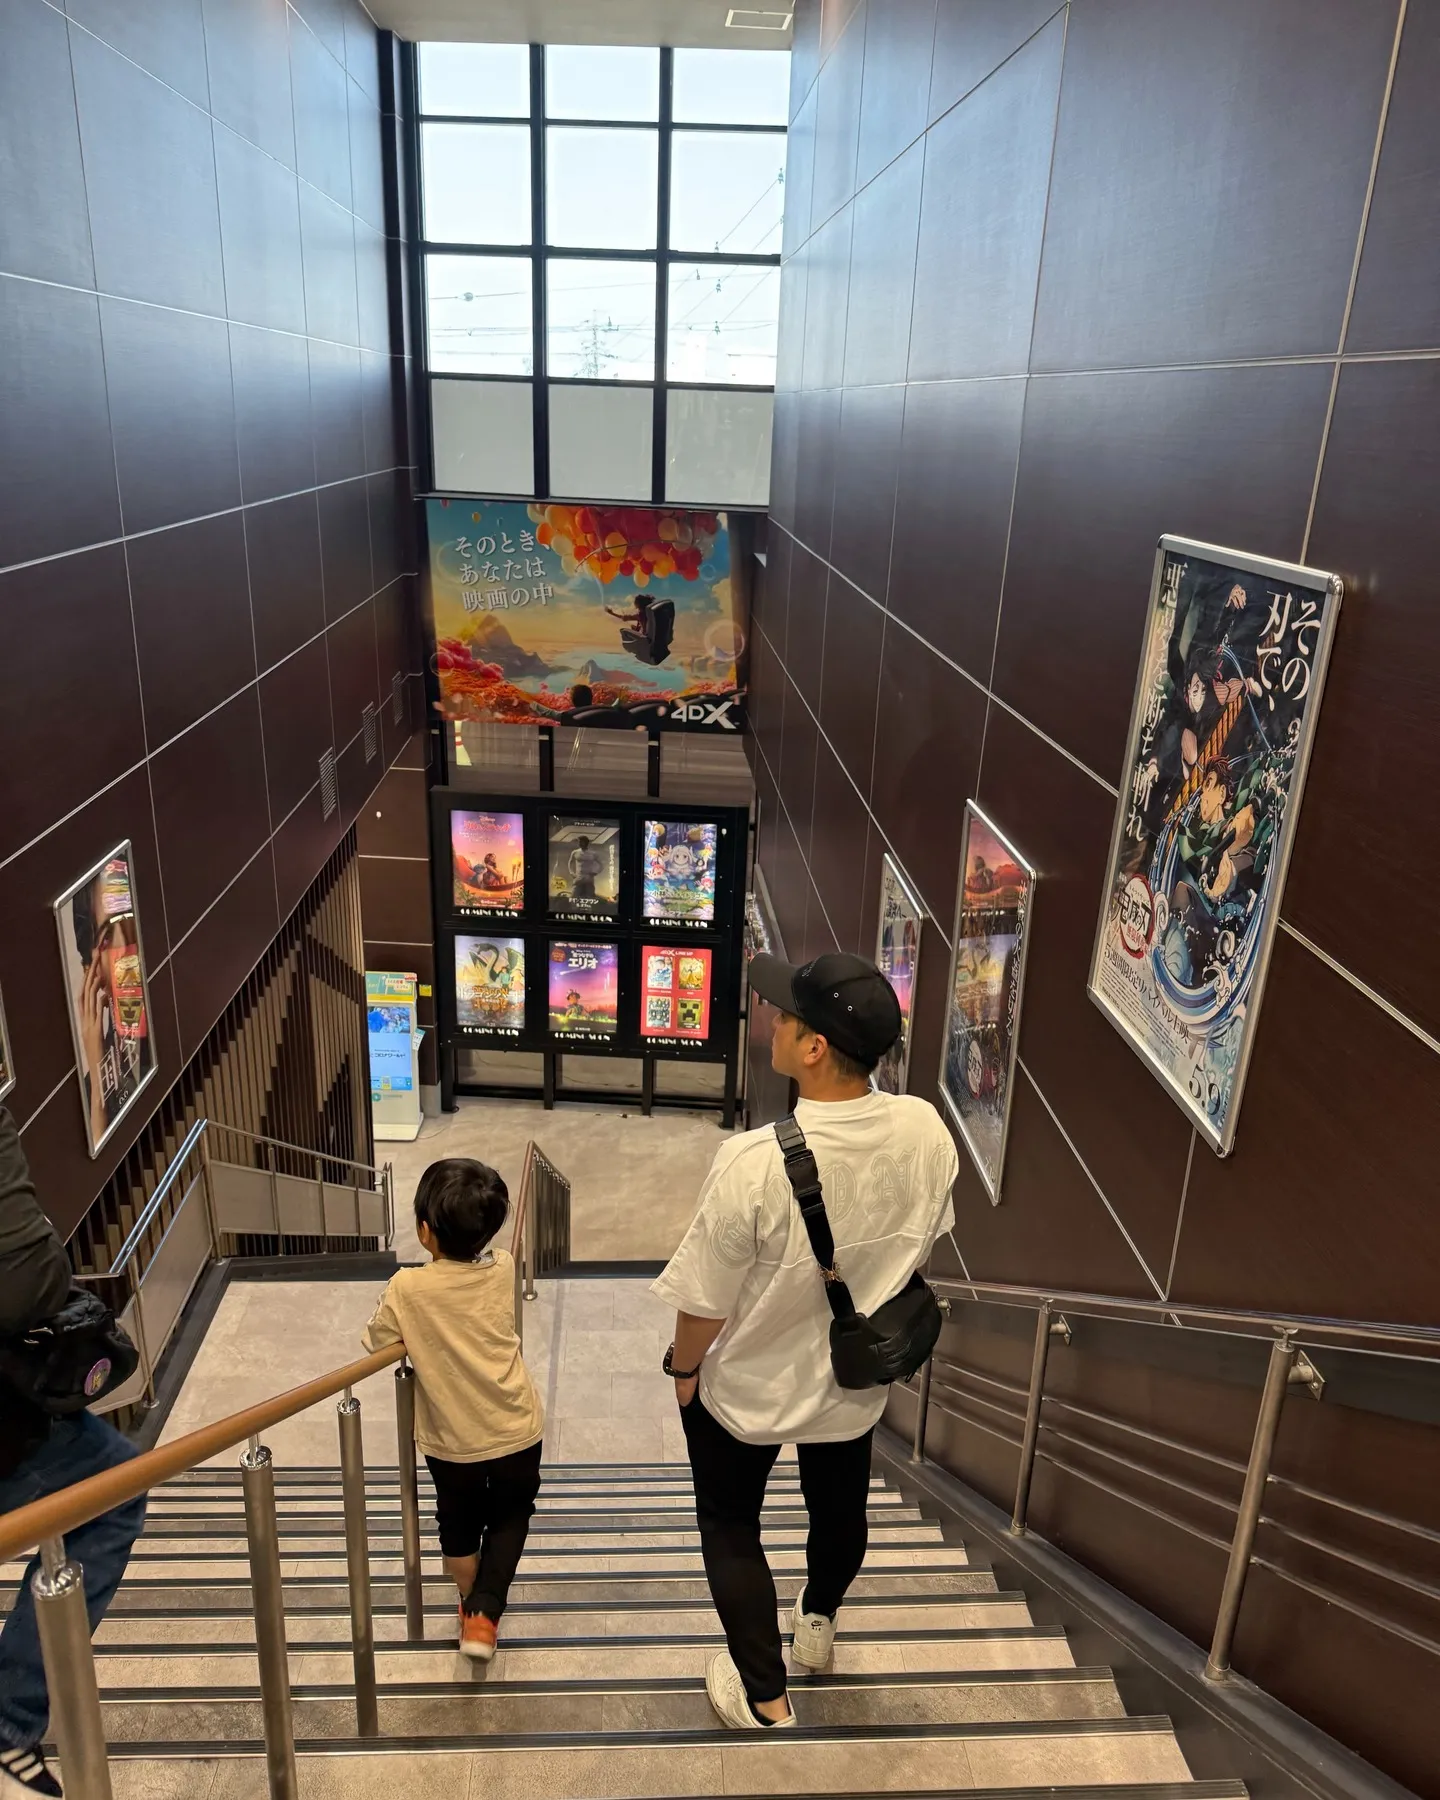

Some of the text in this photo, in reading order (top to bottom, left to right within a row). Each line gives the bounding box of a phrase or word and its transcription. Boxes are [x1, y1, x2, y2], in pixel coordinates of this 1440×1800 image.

[455, 529, 550, 558] そのとき、
[459, 556, 546, 585] あなたは
[462, 582, 554, 613] 映画の中
[1256, 590, 1293, 711] 刃で、
[1281, 599, 1321, 701] その
[671, 701, 737, 729] 4DX
[568, 957, 599, 969] エリオ
[1189, 1064, 1221, 1115] 5.9
